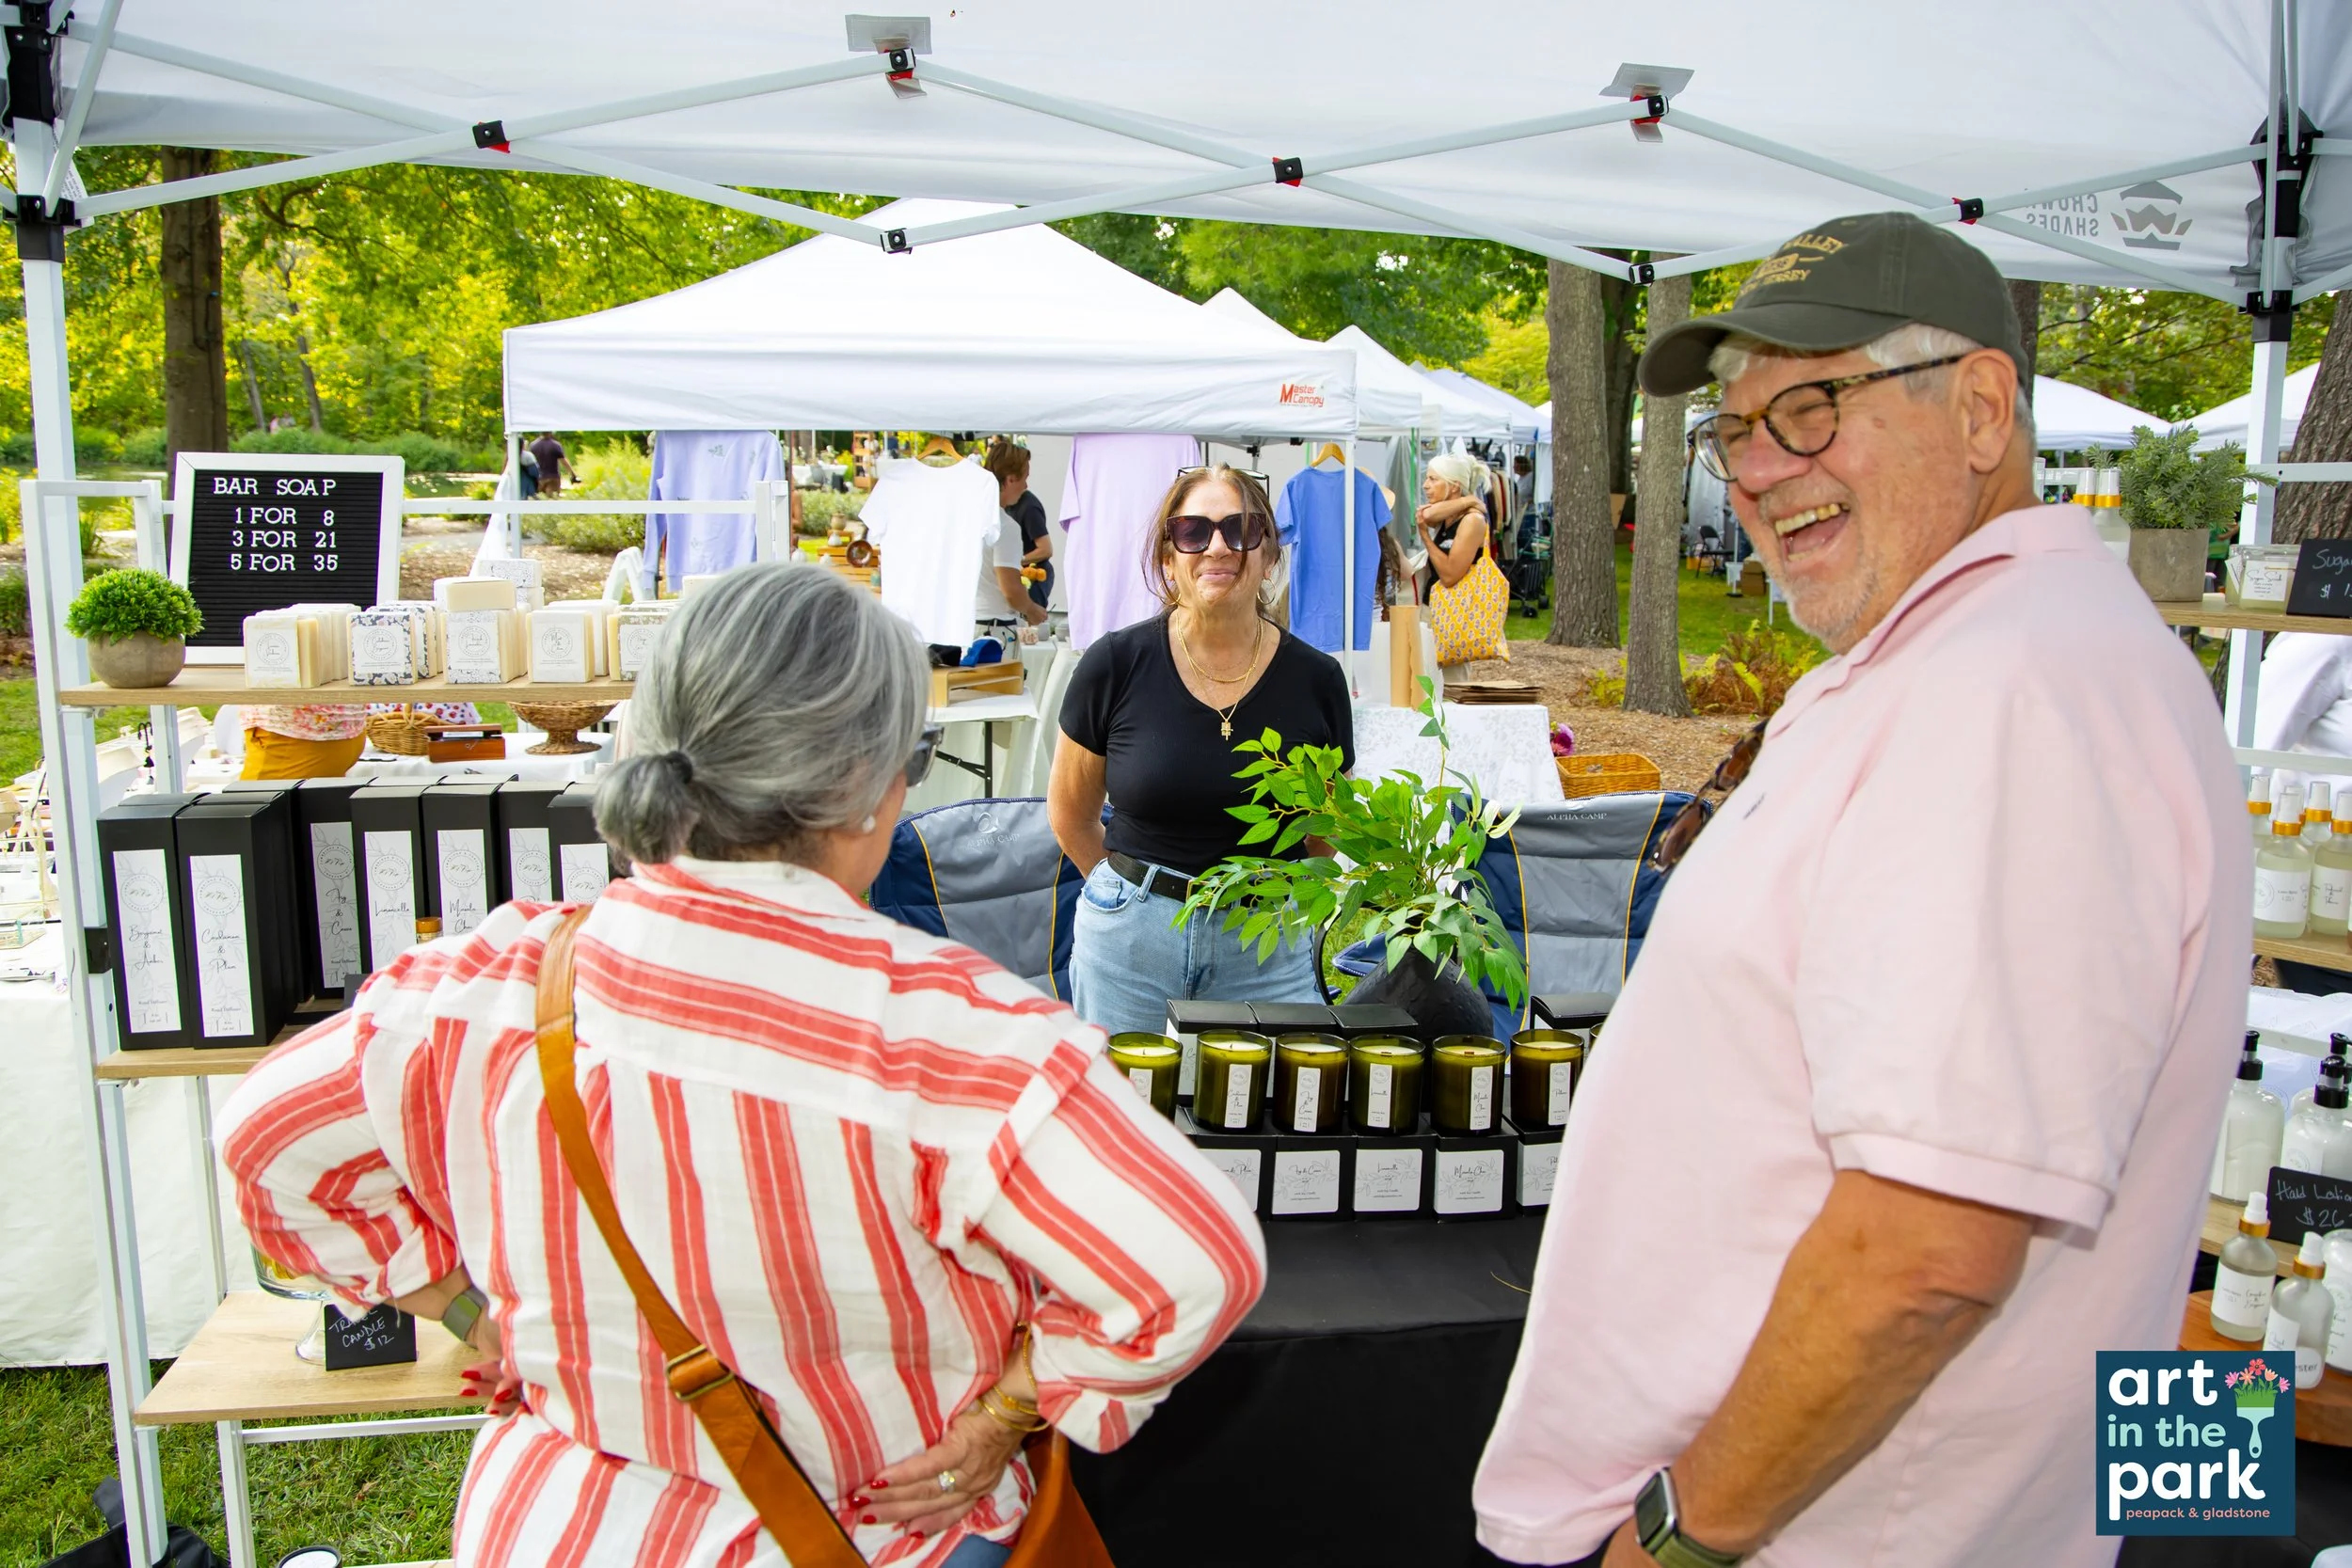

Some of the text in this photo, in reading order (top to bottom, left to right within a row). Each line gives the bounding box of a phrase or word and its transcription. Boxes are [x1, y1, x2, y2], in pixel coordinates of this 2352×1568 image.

[1279, 383, 1316, 404] Master
[1293, 393, 1325, 407] Canopy
[214, 477, 336, 497] BAR SOAP
[235, 507, 335, 527] 1 FOR 8
[232, 531, 337, 548] 3 FOR 21
[230, 553, 339, 572] 5 FOR 35
[2312, 548, 2352, 576] Suga
[342, 1317, 386, 1348] CANDLE
[363, 1335, 395, 1351] $12
